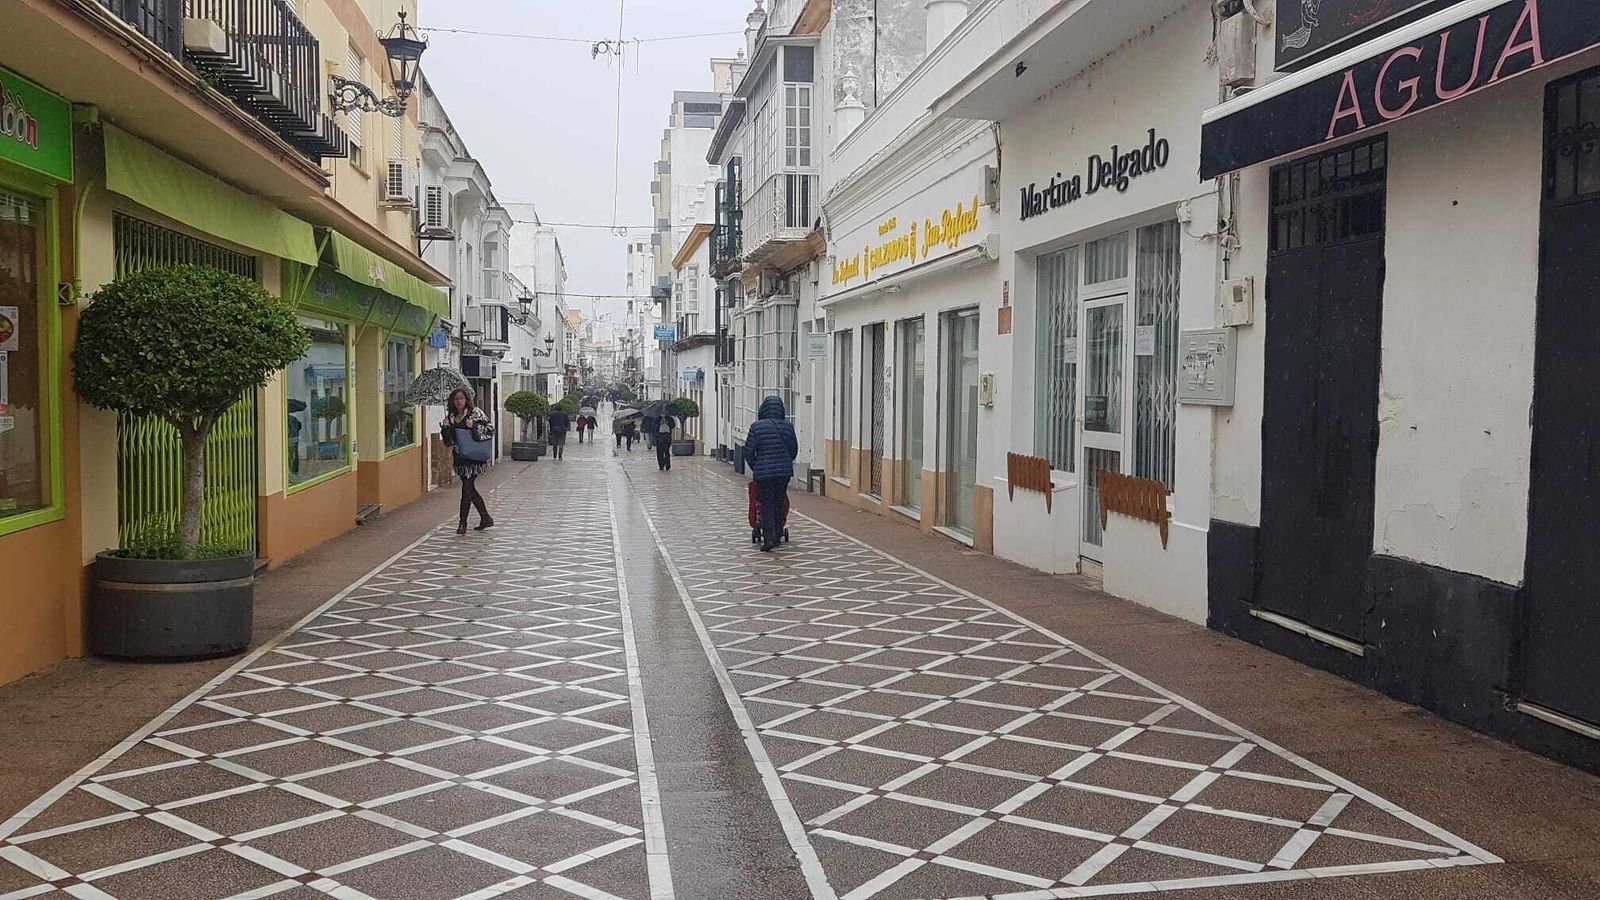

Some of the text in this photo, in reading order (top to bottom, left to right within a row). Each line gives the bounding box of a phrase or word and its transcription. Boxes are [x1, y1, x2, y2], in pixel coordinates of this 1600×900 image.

[1325, 0, 1544, 141] AGUA
[1020, 128, 1169, 221] Martina Delgado
[921, 218, 940, 257] San
[939, 194, 978, 249] Rafael
